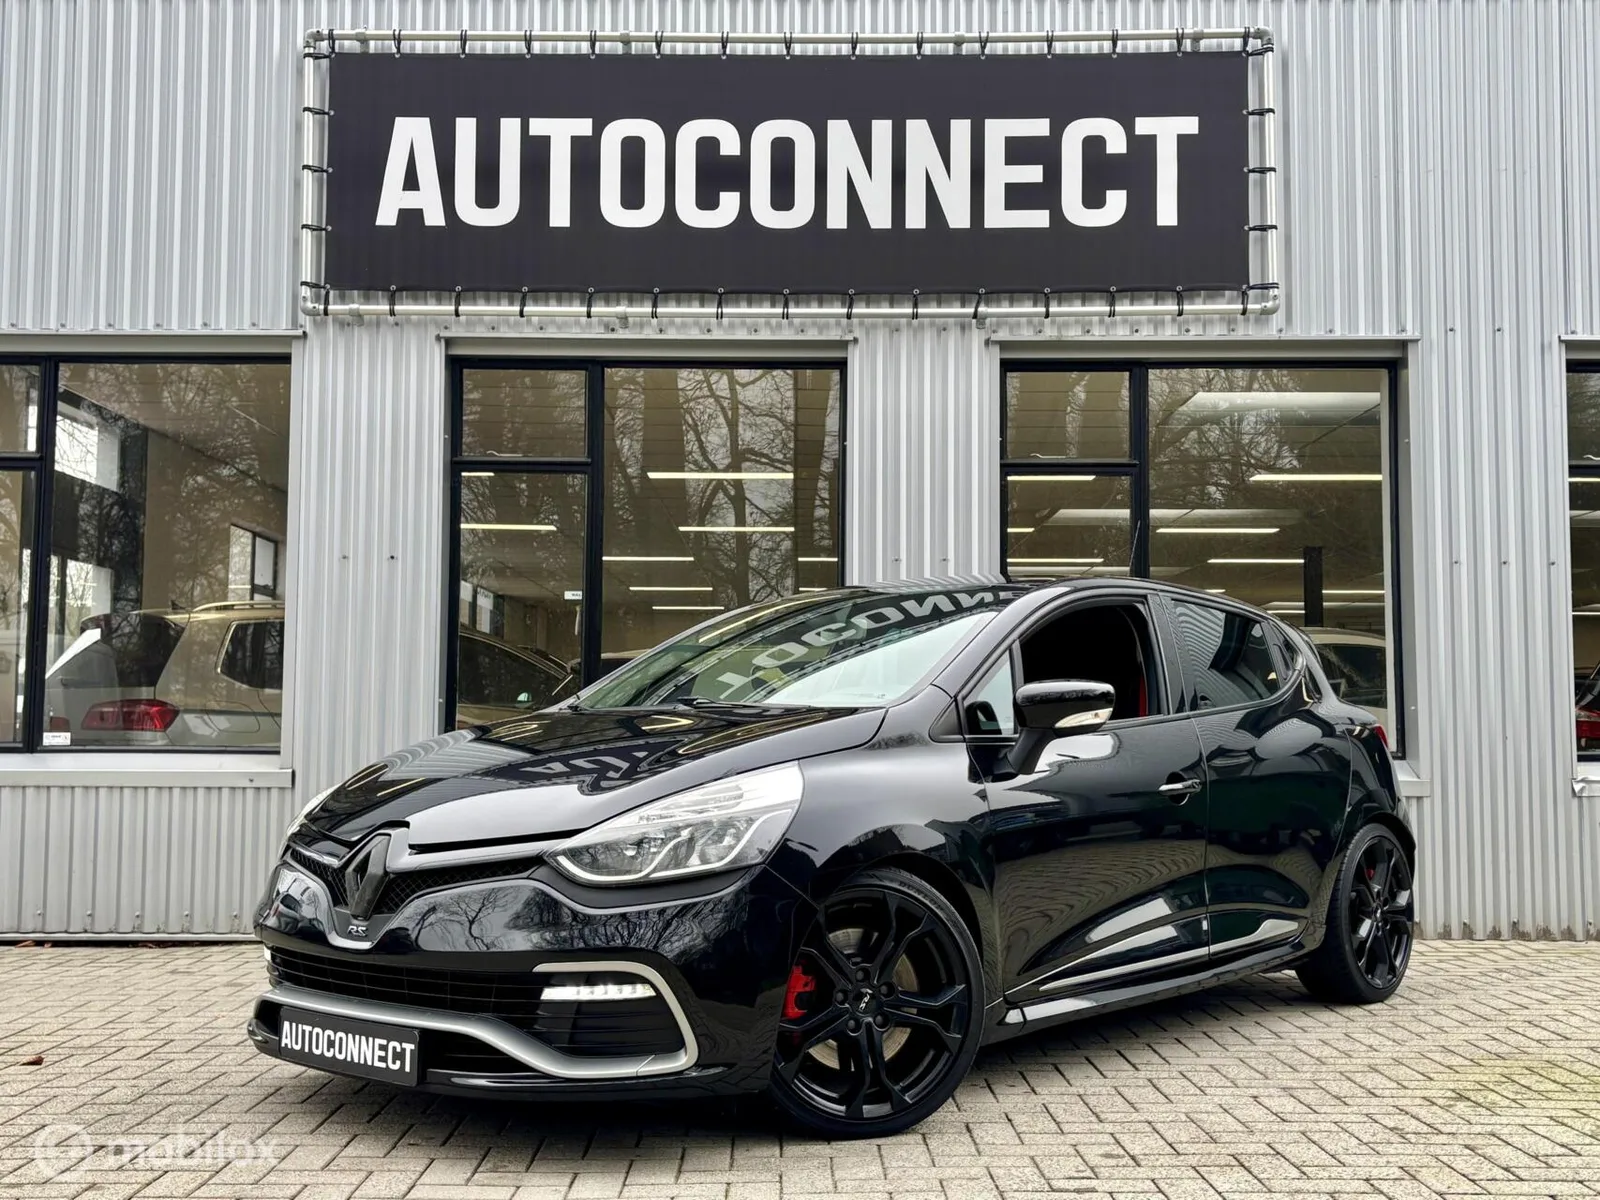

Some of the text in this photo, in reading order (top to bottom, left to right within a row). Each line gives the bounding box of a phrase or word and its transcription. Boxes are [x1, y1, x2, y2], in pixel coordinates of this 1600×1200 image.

[375, 116, 1199, 229] AUTOCONNECT
[346, 925, 367, 937] RS
[280, 1020, 416, 1073] AUTOCONNECT
